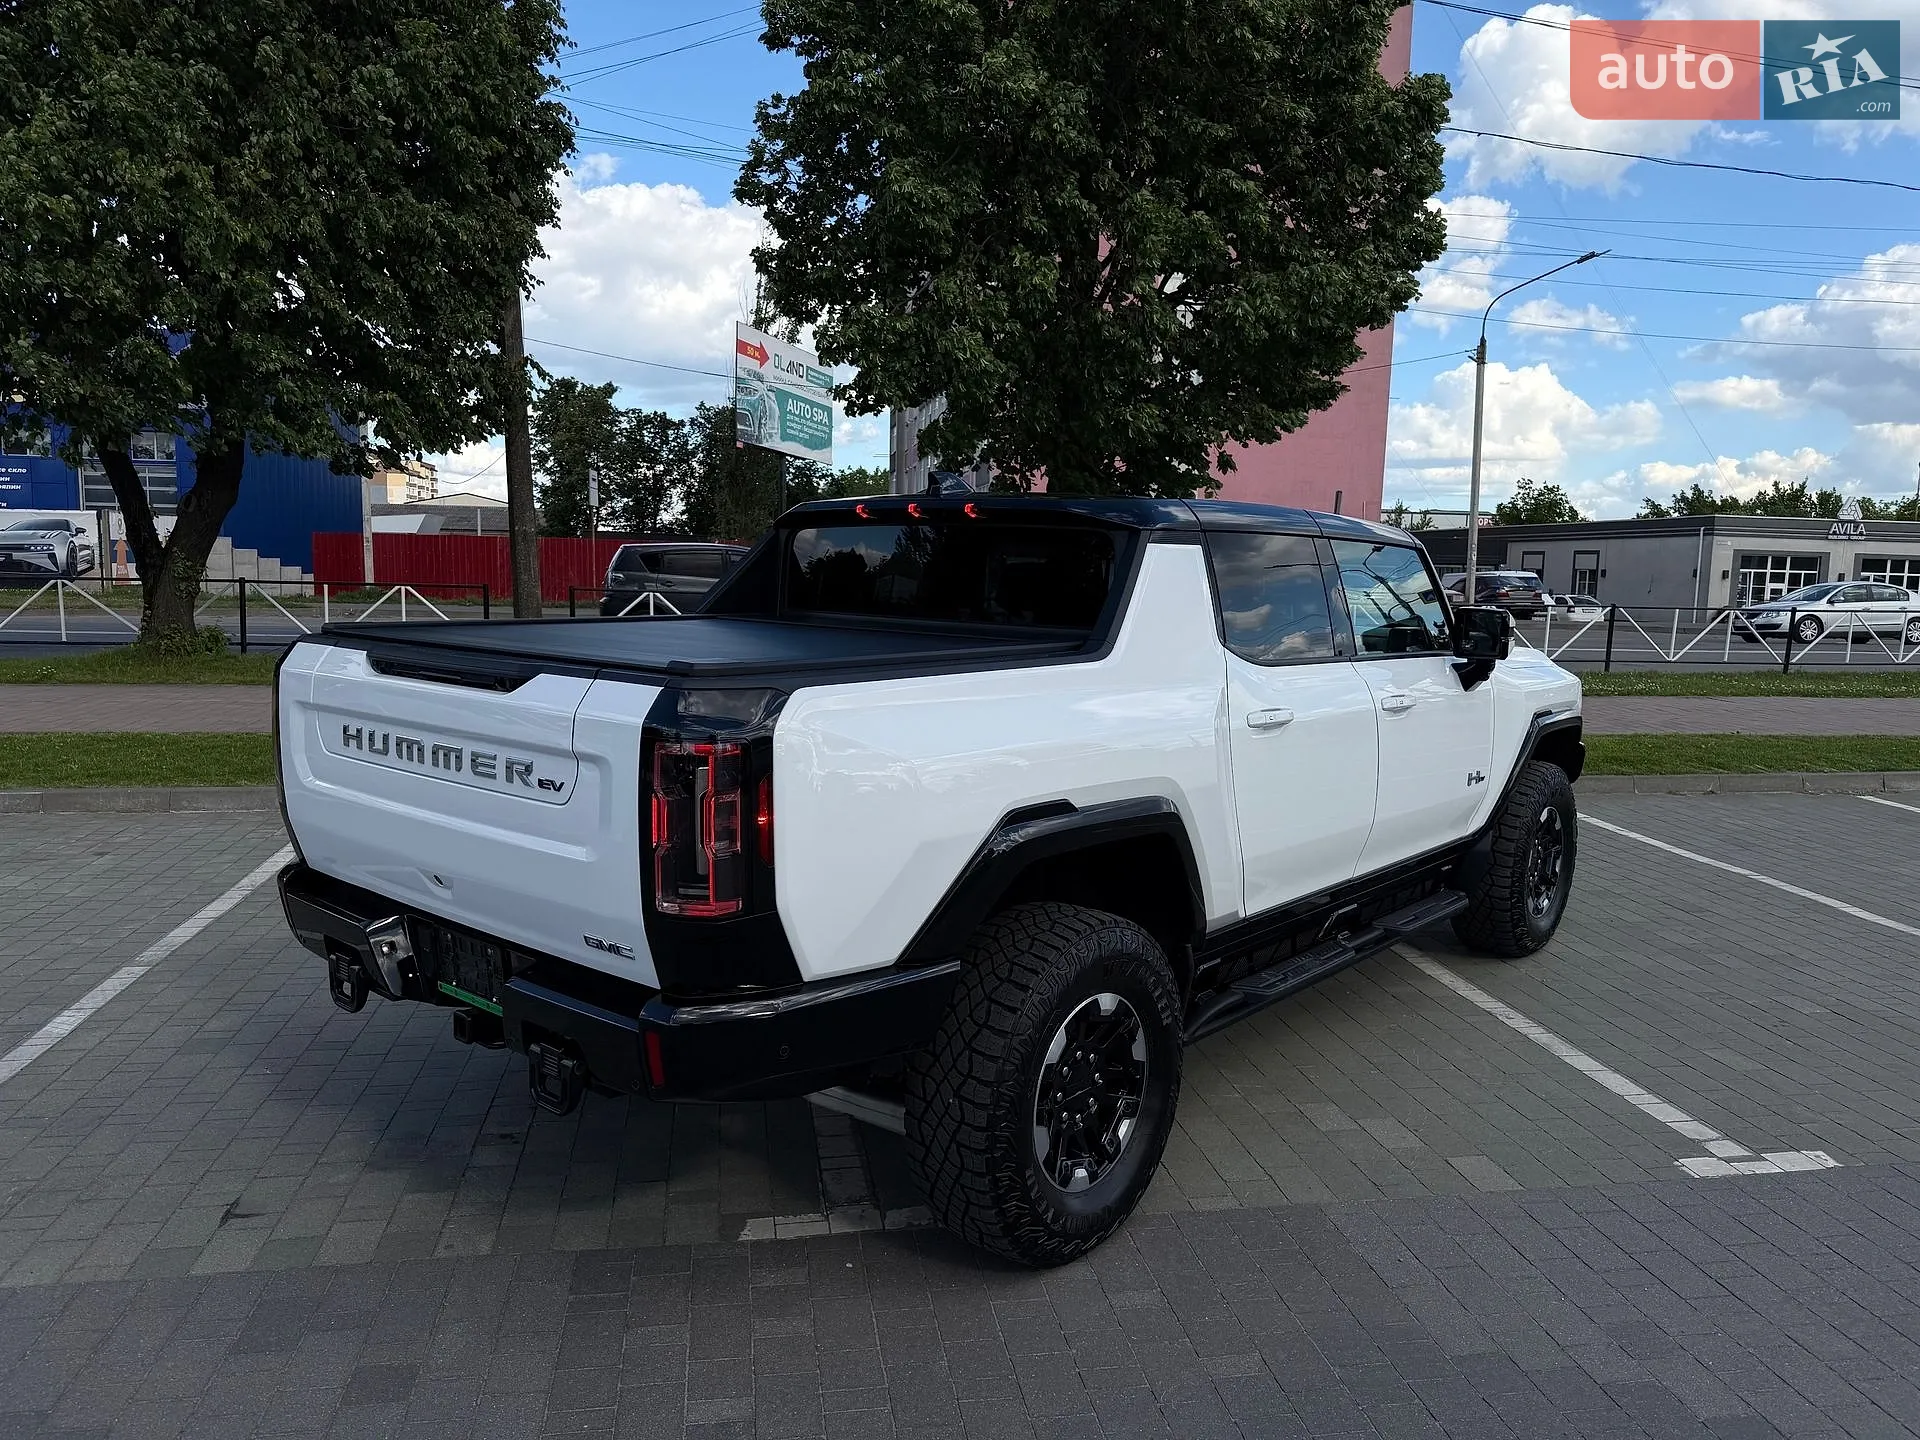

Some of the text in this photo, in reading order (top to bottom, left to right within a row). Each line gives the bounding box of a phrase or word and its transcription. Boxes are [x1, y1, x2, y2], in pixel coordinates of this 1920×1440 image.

[774, 353, 804, 379] OLAND
[786, 398, 811, 419] AUTO
[812, 407, 830, 426] SPA
[1829, 523, 1866, 534] AVILA
[342, 723, 566, 793] HUMMER EV
[583, 933, 636, 960] GMC
